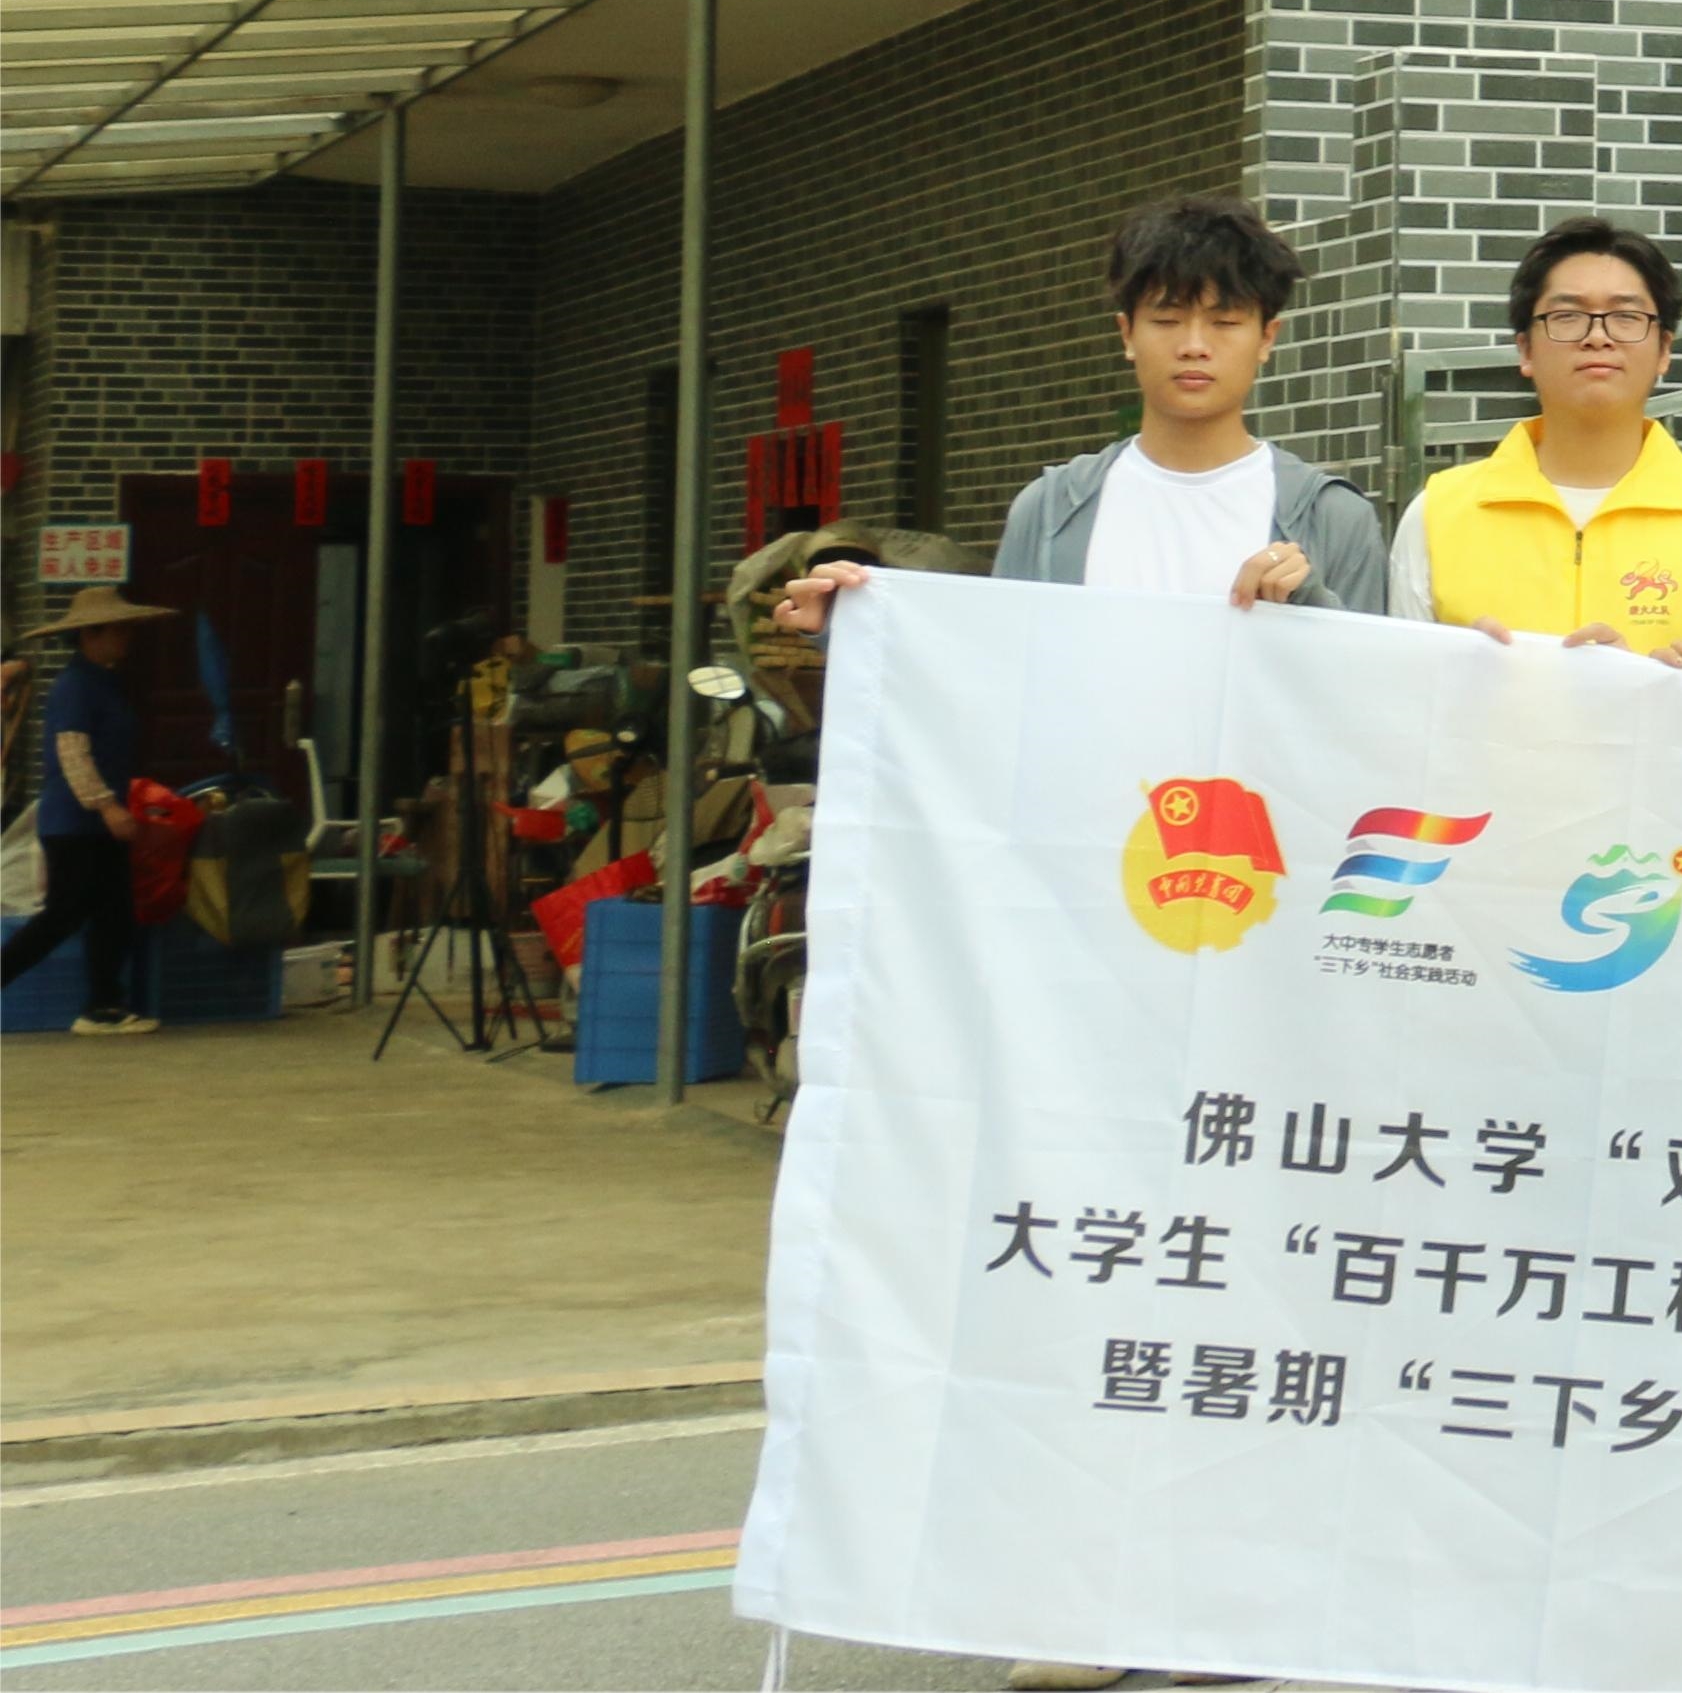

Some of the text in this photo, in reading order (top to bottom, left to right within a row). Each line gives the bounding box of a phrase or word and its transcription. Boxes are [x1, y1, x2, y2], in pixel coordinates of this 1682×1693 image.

[1322, 933, 1455, 962] 大中专学生志愿者
